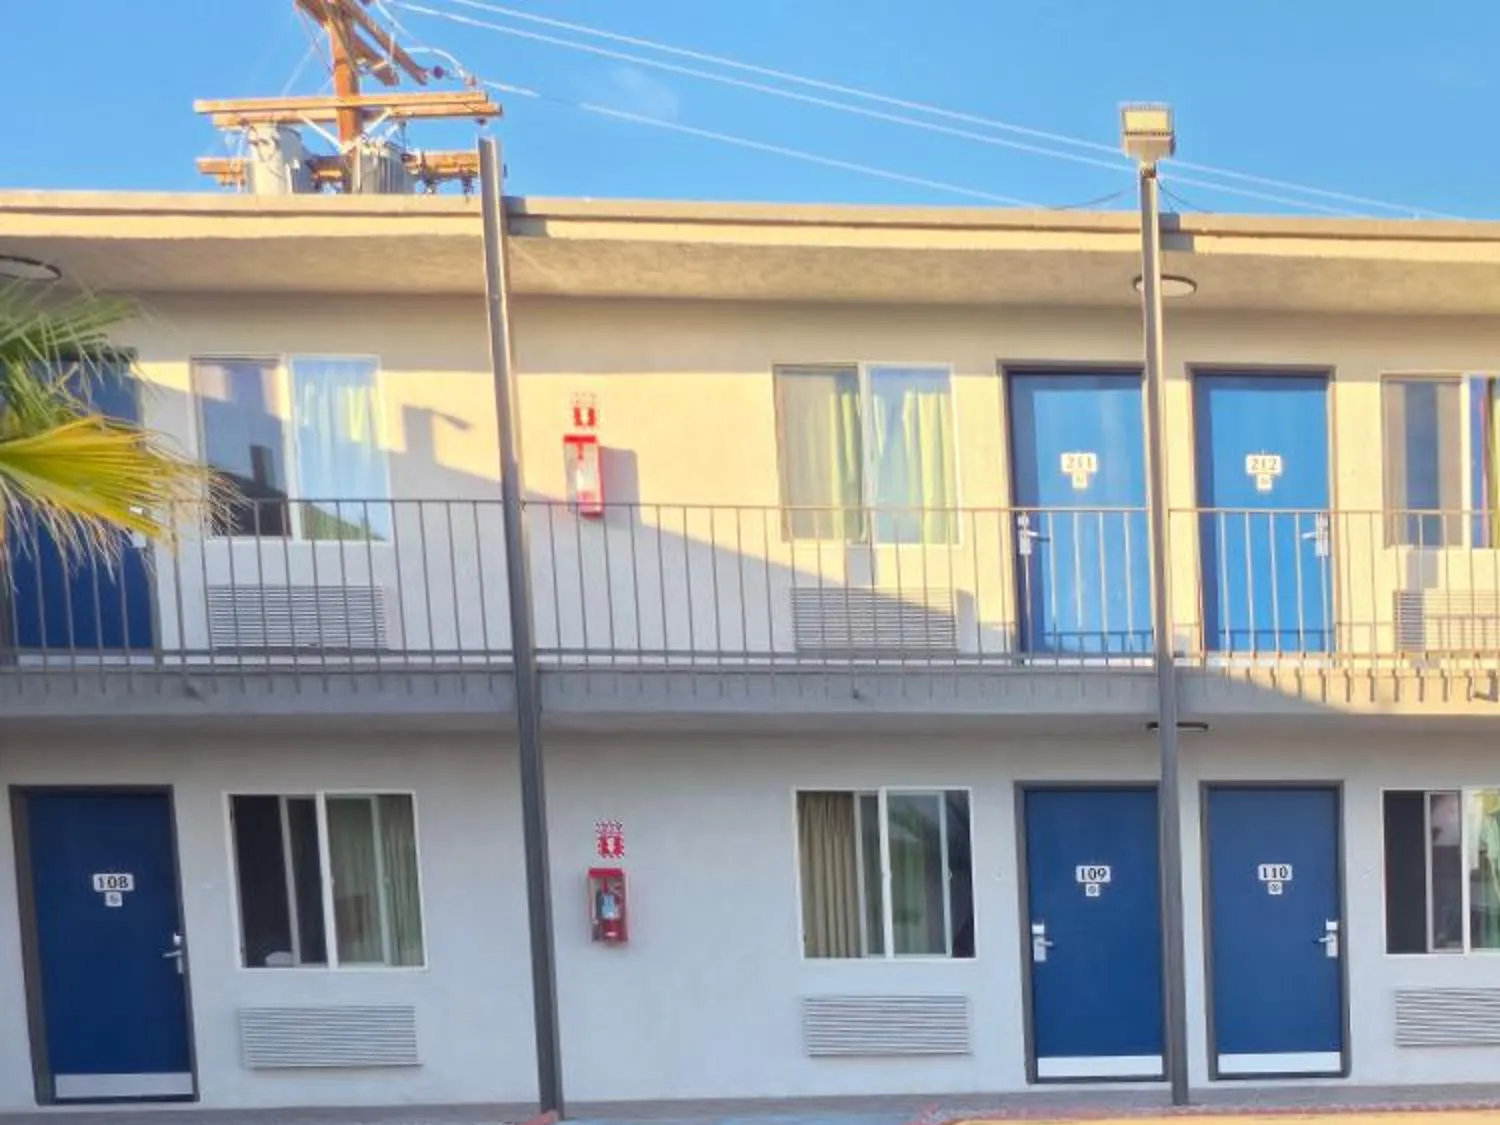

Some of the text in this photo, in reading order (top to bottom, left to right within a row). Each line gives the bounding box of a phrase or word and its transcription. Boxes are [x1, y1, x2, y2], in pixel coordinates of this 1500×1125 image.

[1066, 457, 1092, 469] 211
[1249, 458, 1278, 471] 212
[1081, 868, 1106, 881] 109
[1262, 866, 1288, 880] 110
[98, 875, 129, 890] 108
